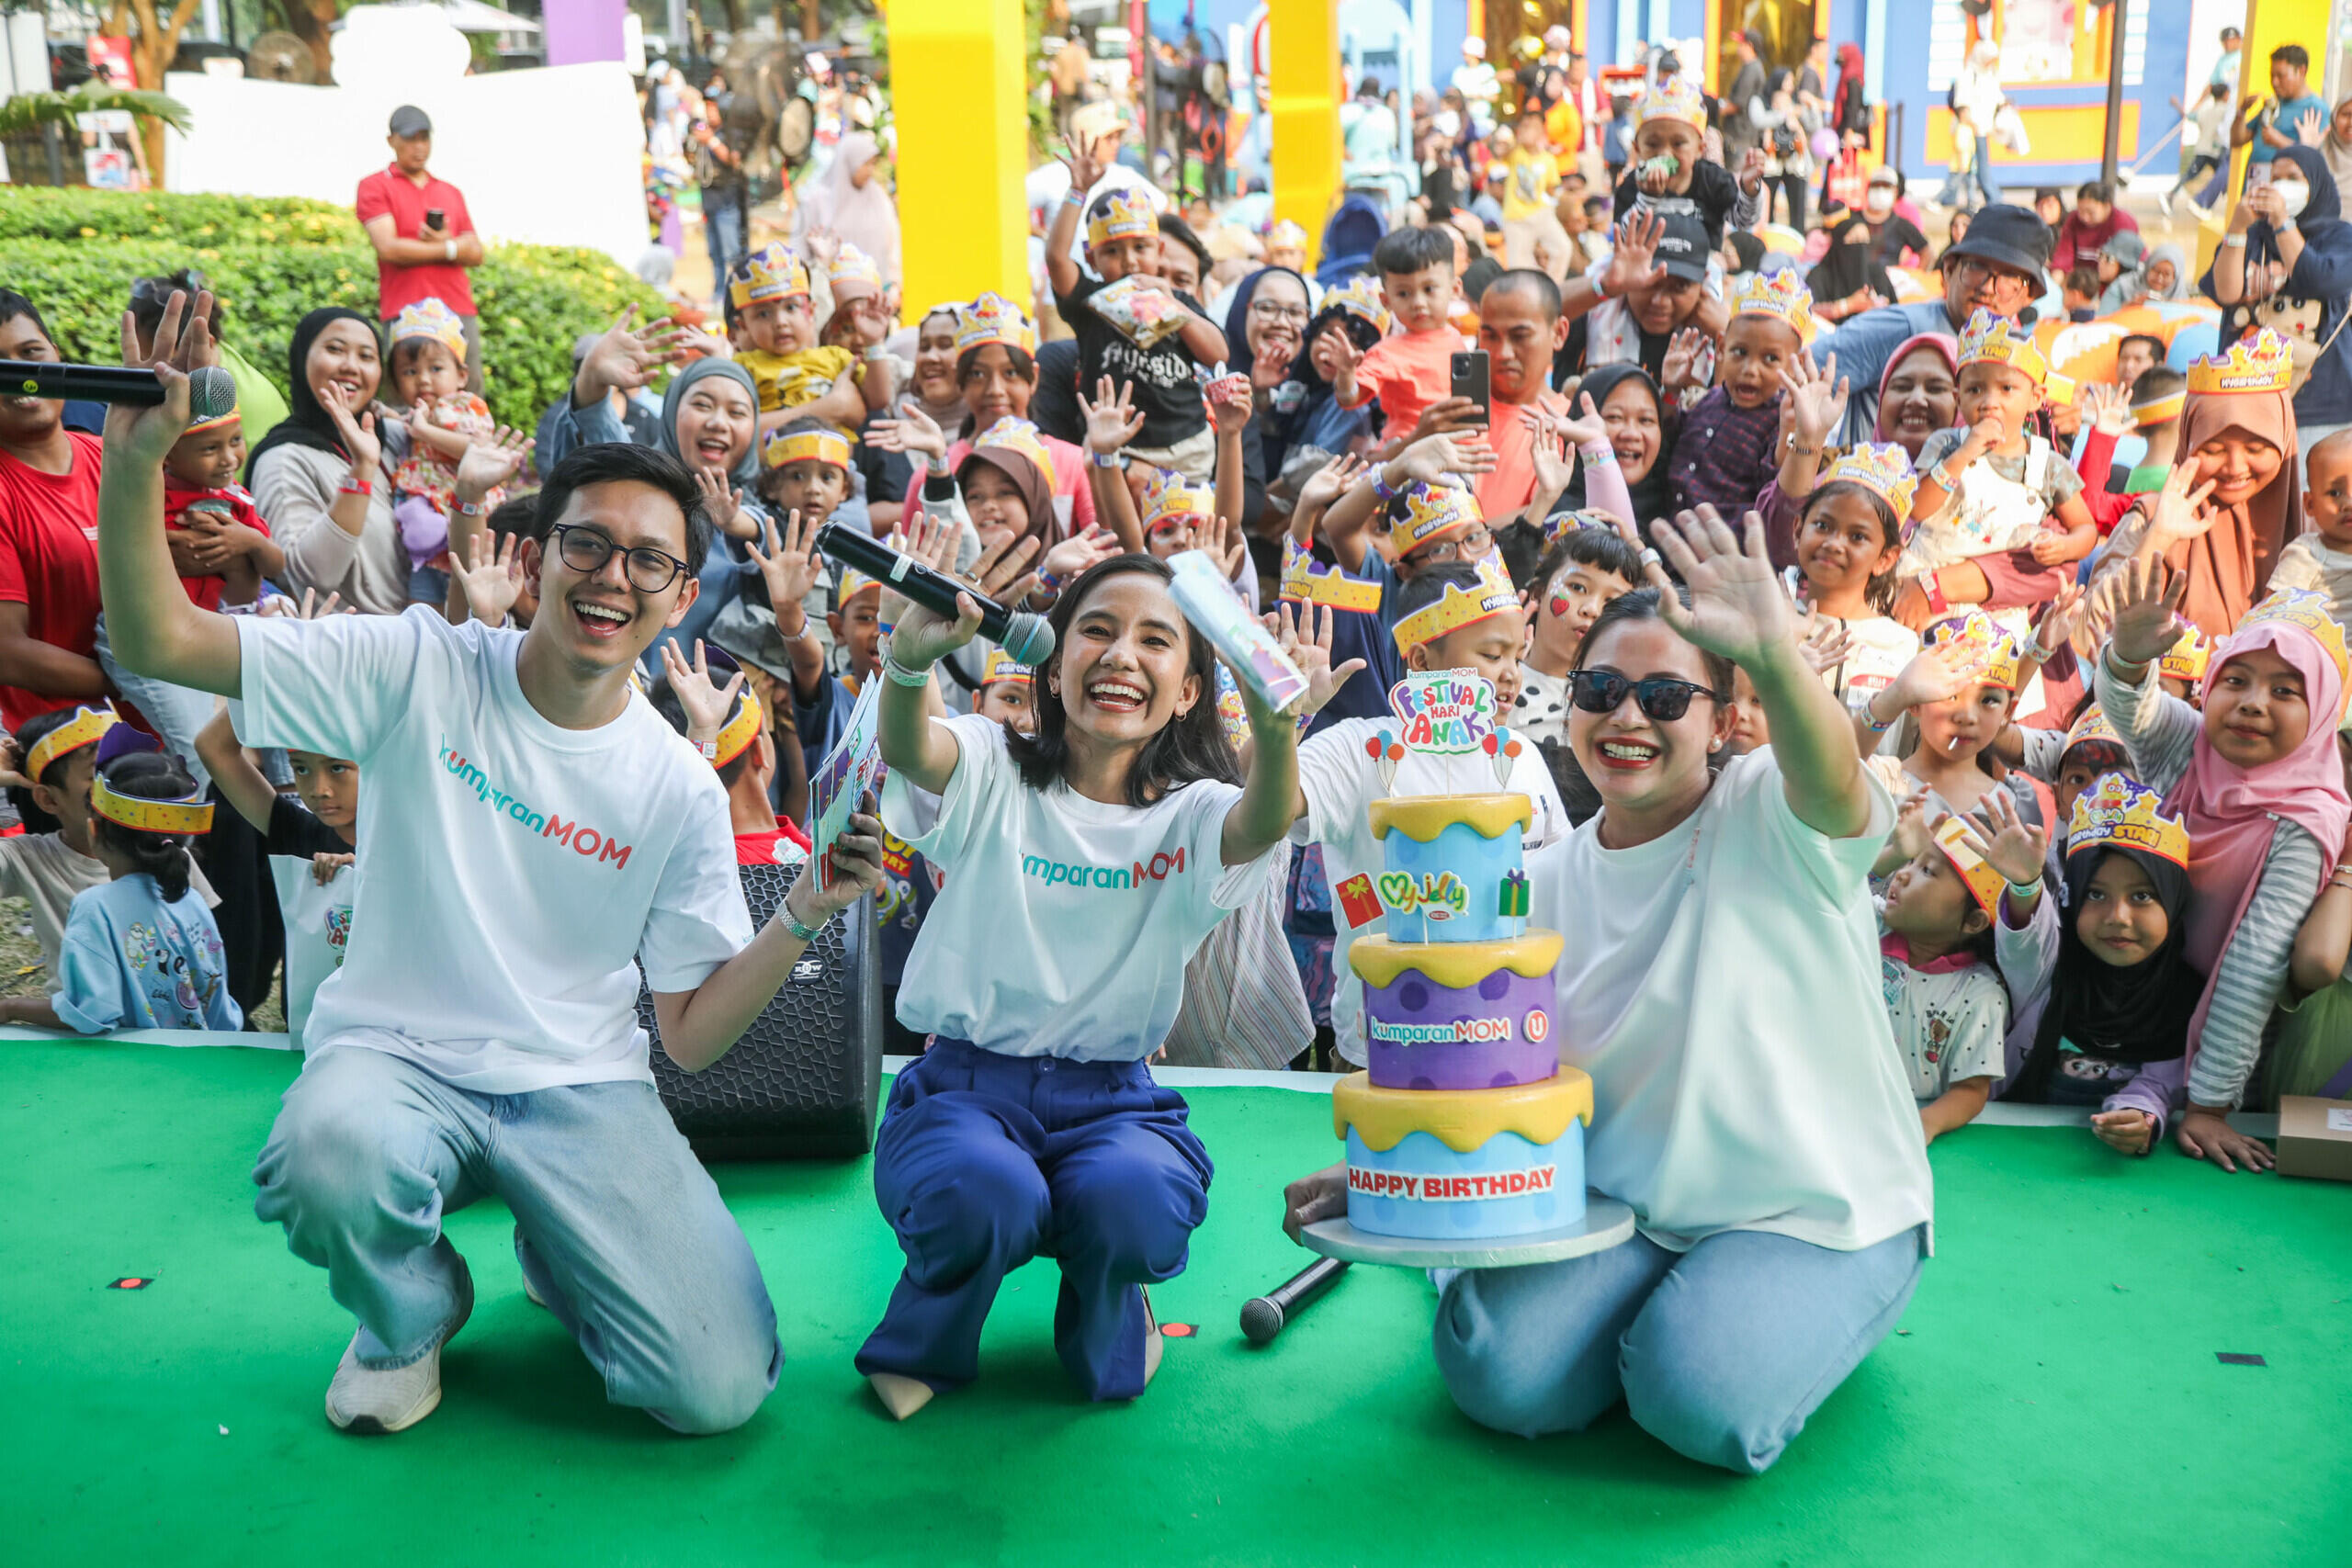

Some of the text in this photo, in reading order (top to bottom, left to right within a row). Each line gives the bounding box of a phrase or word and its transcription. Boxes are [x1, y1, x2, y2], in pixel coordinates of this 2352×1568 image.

[1408, 668, 1477, 680] kumparanMOM
[1397, 680, 1487, 718] FESTIVAL
[1430, 705, 1460, 718] HARI
[1408, 711, 1486, 746] ANAK
[2113, 825, 2160, 849] STAR
[882, 851, 910, 871] ORY
[1020, 846, 1185, 890] mparanMOM
[1372, 1019, 1510, 1045] kumparanMOM
[1349, 1167, 1555, 1198] HAPPY BIRTHDAY
